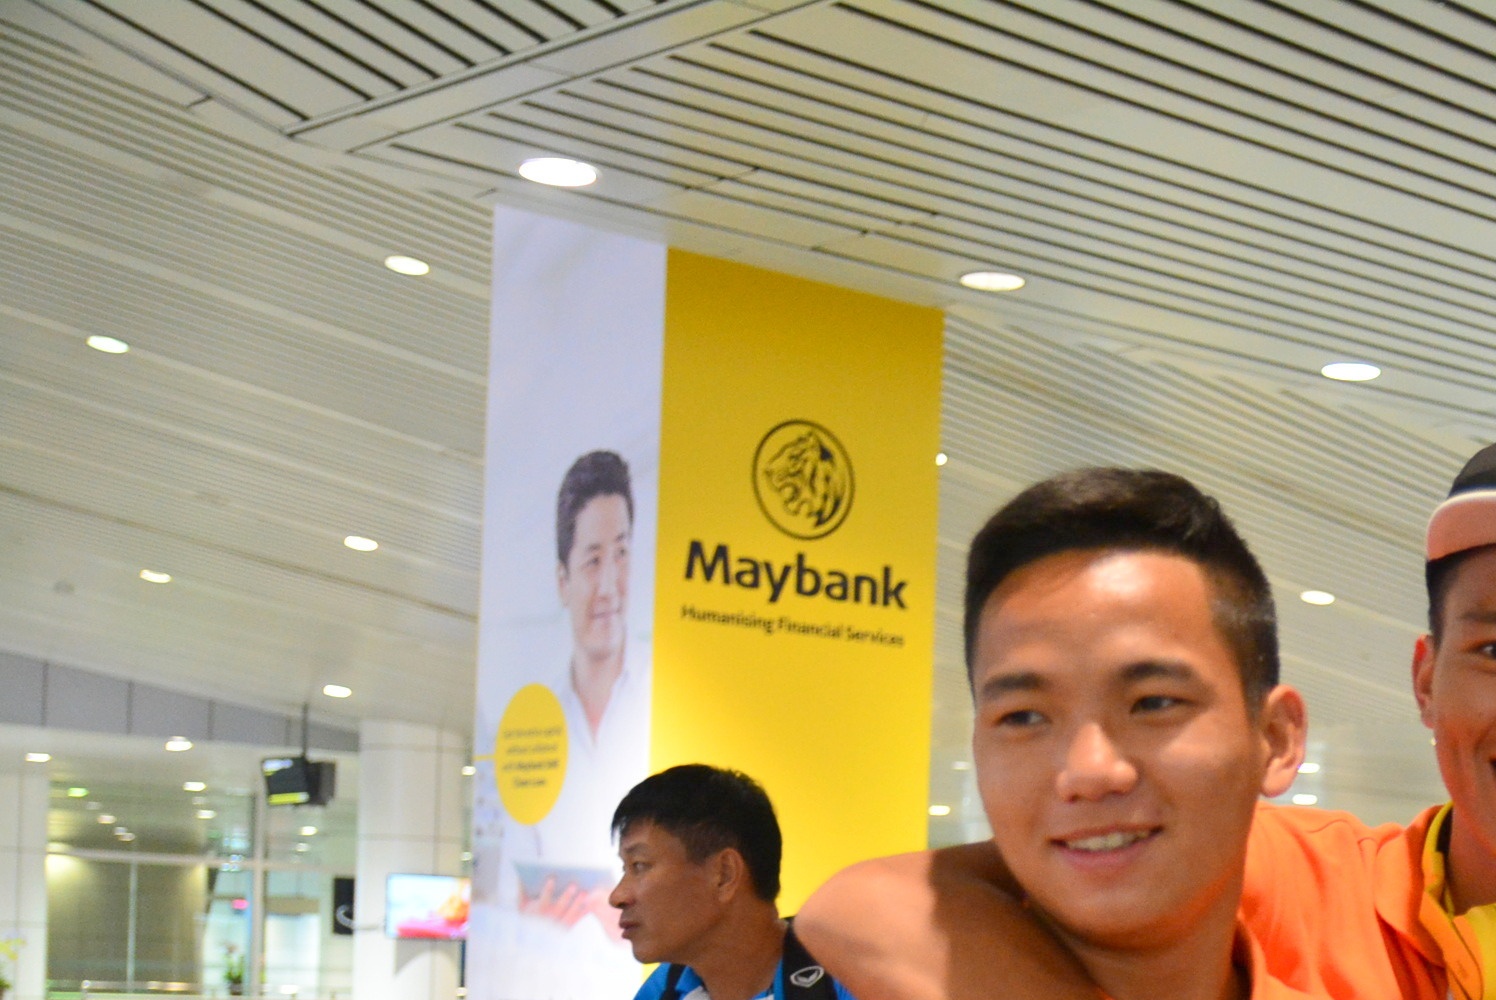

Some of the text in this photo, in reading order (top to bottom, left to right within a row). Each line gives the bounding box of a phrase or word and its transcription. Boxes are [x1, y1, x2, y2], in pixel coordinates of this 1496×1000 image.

[684, 540, 908, 610] Maybank
[680, 604, 905, 647] Humanising Financial Services
